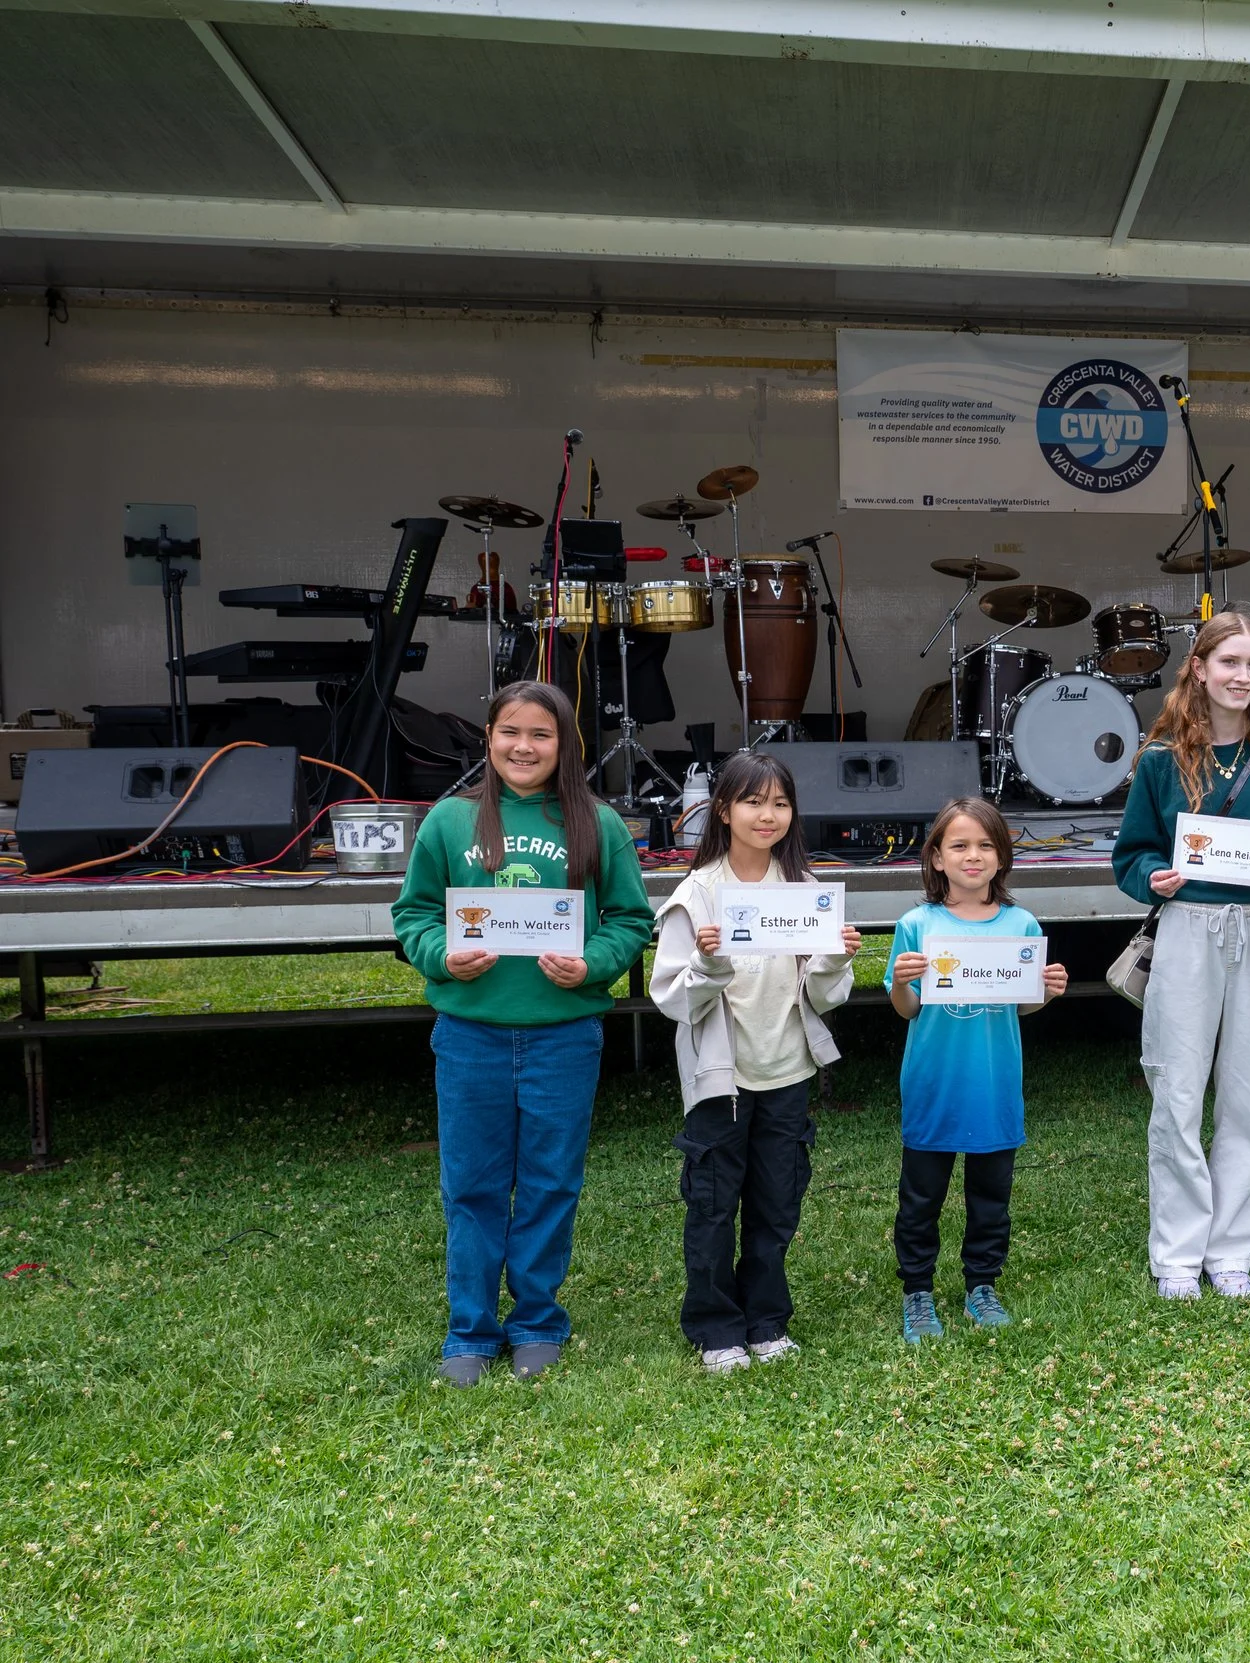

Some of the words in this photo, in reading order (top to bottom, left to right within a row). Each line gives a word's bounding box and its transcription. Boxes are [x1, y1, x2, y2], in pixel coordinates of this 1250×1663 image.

[1047, 364, 1116, 407] CRESCENTA
[1119, 369, 1158, 410] VALLEY
[880, 398, 920, 408] Providing
[921, 399, 950, 409] quality
[951, 400, 972, 409] water
[973, 401, 993, 409] and
[911, 412, 945, 420] services
[946, 412, 955, 420] to
[956, 412, 970, 420] the
[971, 413, 1017, 423] community
[868, 422, 877, 430] in
[885, 423, 933, 432] dependable
[935, 423, 951, 432] and
[952, 424, 1006, 434] economically
[1060, 412, 1144, 442] CVWD
[872, 435, 920, 444] responsible
[921, 436, 953, 444] manner
[955, 436, 976, 444] since
[978, 436, 1001, 445] 1950.
[1049, 447, 1095, 488] WATER
[1098, 448, 1156, 489] DISTRICT
[854, 496, 914, 505] www.cvwd.com
[935, 497, 1050, 507] @CrescentaValleyWaterDistrict
[392, 548, 418, 616] ULTIMATE
[1052, 685, 1088, 702] Pearl
[1210, 847, 1232, 858] Lena
[490, 919, 519, 929] Penh
[523, 920, 570, 931] Walters
[760, 916, 799, 928] Esther
[803, 916, 819, 927] Uh
[962, 968, 993, 978] Blake
[996, 968, 1022, 980] Ngai
